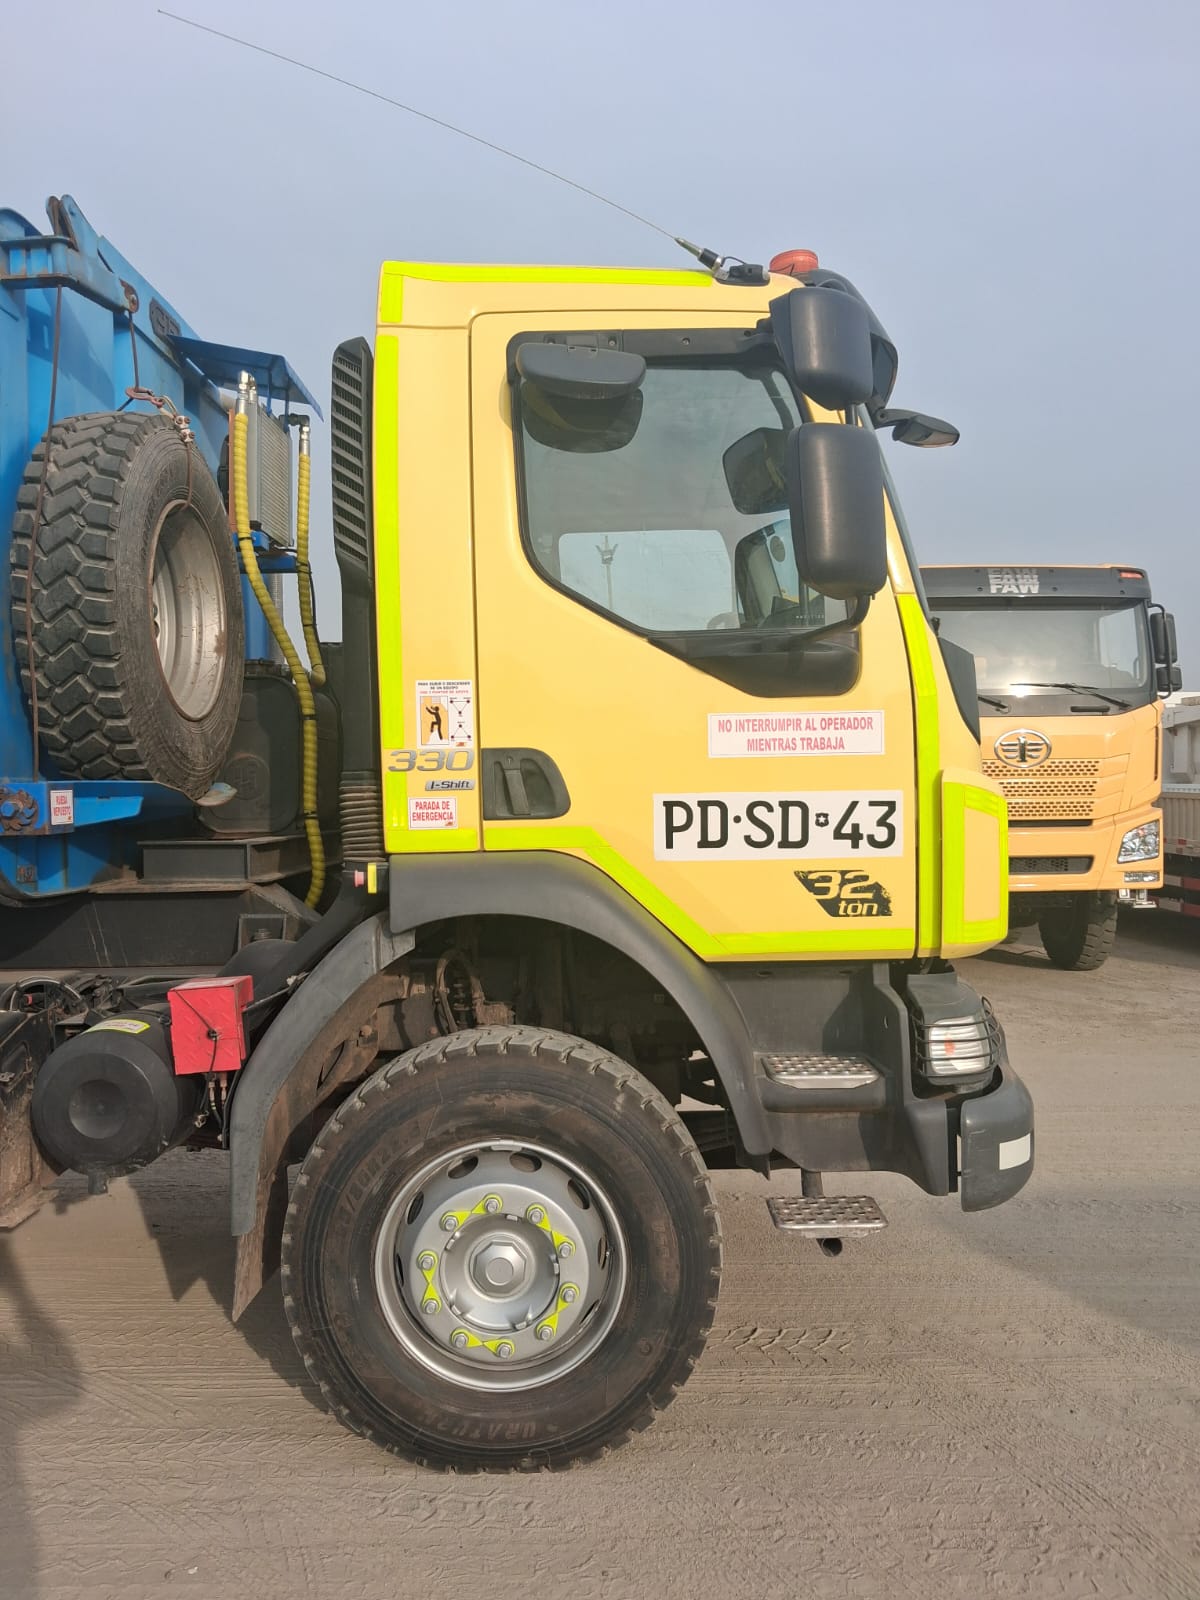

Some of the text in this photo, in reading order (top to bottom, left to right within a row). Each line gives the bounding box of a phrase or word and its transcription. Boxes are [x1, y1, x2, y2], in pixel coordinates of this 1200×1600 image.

[718, 717, 873, 733] NO INTERRUMPIR AL OPERADOR
[747, 737, 845, 752] MIENTRAS TRABAJA
[388, 749, 475, 772] 330
[430, 780, 470, 790] I-Shift
[415, 800, 451, 810] PARADA DE
[412, 812, 454, 822] EMERGENCIA
[806, 871, 874, 899] 32
